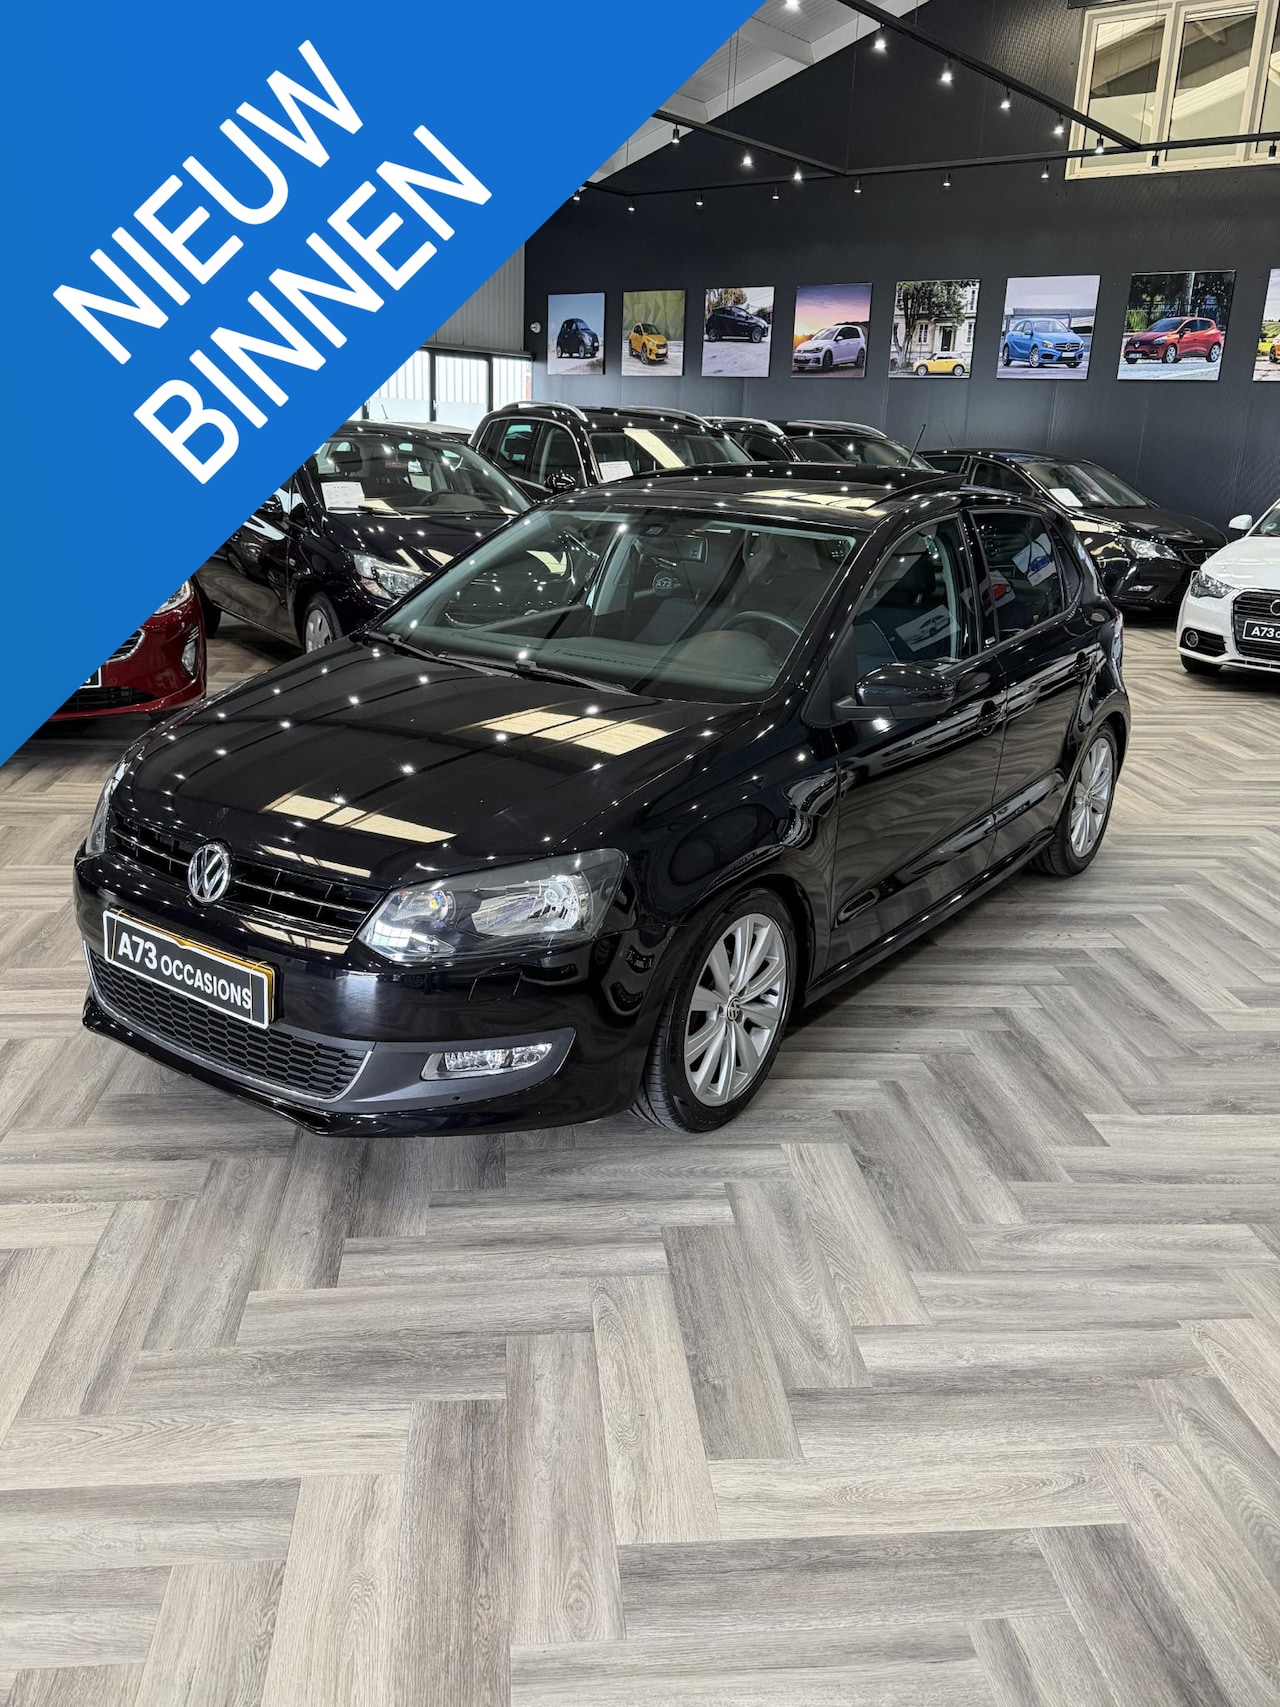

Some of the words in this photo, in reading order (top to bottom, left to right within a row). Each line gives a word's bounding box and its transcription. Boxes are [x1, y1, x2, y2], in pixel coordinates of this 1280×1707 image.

[1251, 626, 1275, 638] A73
[118, 931, 158, 970] A73
[160, 955, 252, 1010] OCCASIONS
